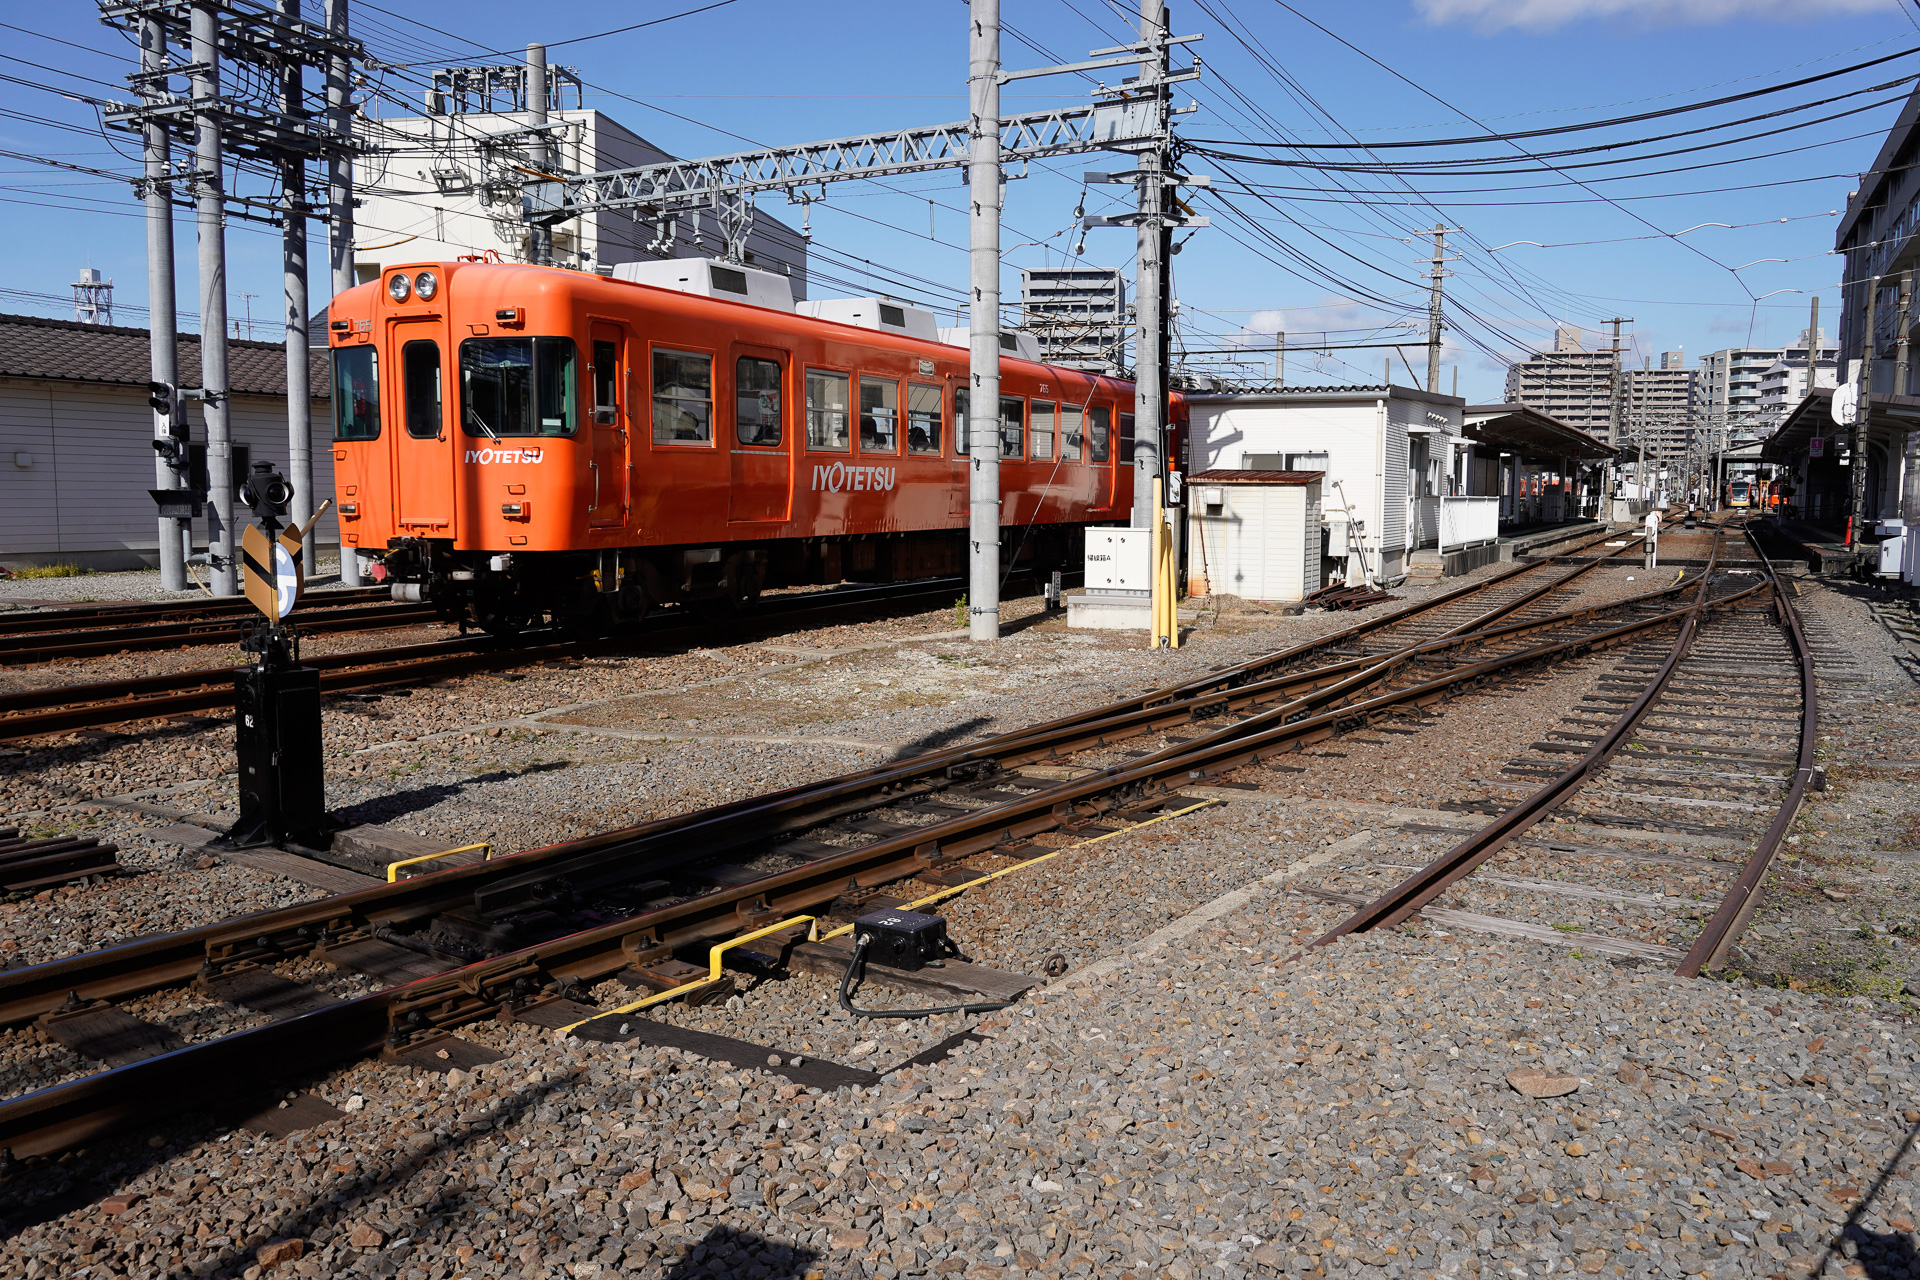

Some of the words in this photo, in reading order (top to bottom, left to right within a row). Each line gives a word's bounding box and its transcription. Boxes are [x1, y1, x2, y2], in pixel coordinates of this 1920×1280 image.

[354, 319, 372, 331] 765
[1039, 383, 1049, 394] 765
[464, 448, 544, 465] IYOTETSU
[811, 461, 896, 494] IYOTETSU
[245, 714, 254, 728] 62
